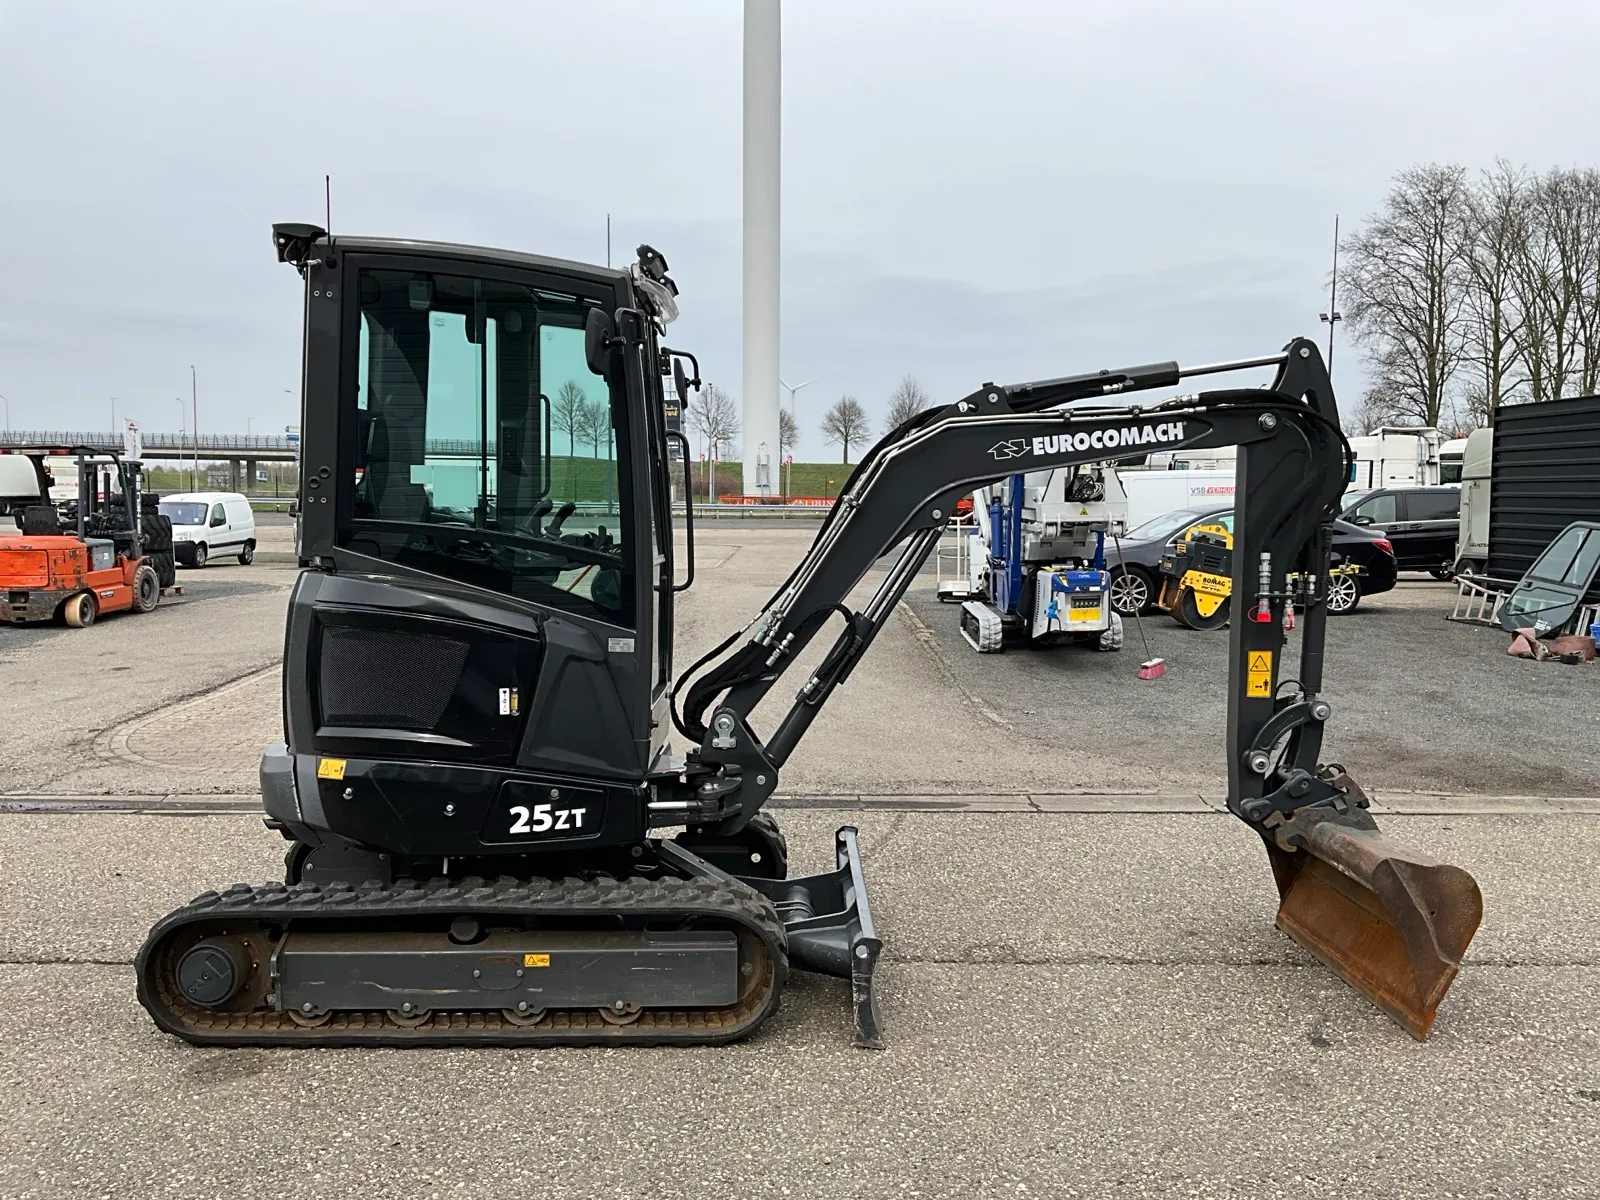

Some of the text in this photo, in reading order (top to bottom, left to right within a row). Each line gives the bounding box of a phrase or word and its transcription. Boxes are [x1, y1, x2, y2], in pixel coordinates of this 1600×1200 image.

[1032, 422, 1184, 455] EUROCOMACH
[1190, 486, 1236, 494] VSB VERHUU
[1202, 577, 1226, 587] BOMAG
[509, 803, 586, 834] 25ZT
